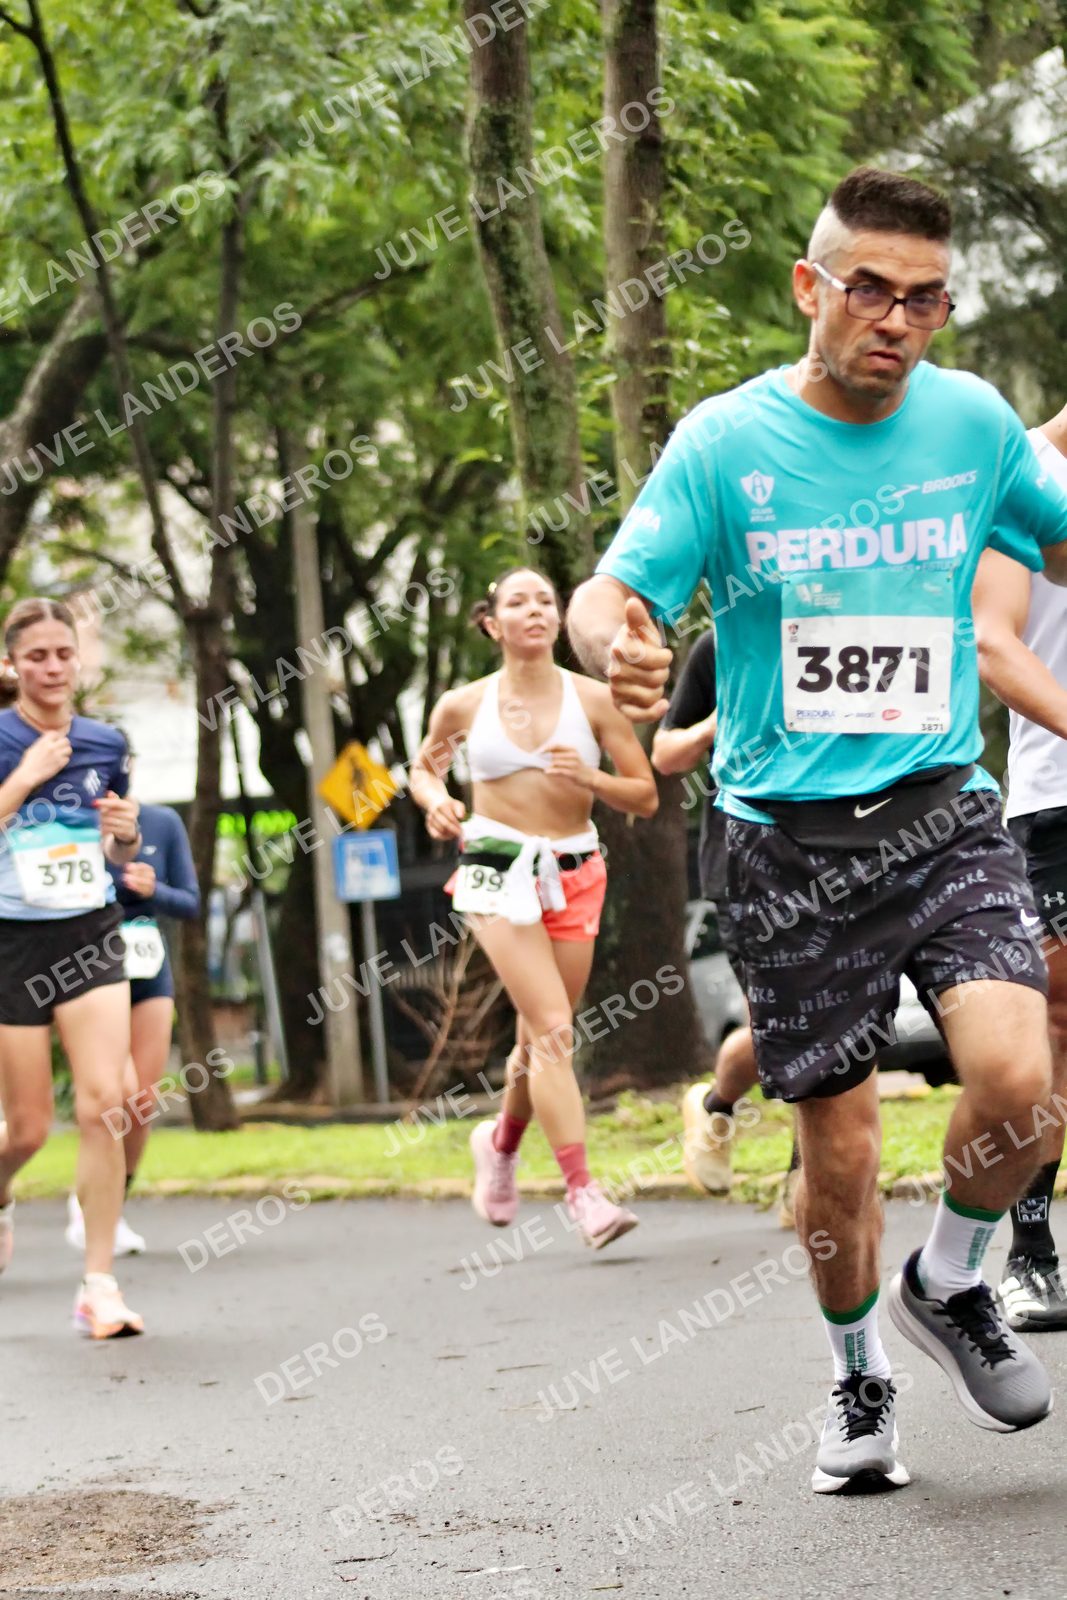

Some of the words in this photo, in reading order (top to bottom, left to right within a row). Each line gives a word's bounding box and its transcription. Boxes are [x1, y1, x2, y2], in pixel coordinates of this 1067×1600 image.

[921, 470, 978, 495] BROOKS
[745, 511, 968, 572] PERDURA
[796, 645, 931, 694] 3871
[921, 723, 944, 731] 3871
[38, 860, 95, 886] 378
[946, 868, 988, 895] nike
[836, 949, 885, 970] nike
[800, 988, 850, 1014] nike
[767, 1014, 809, 1031] nike
